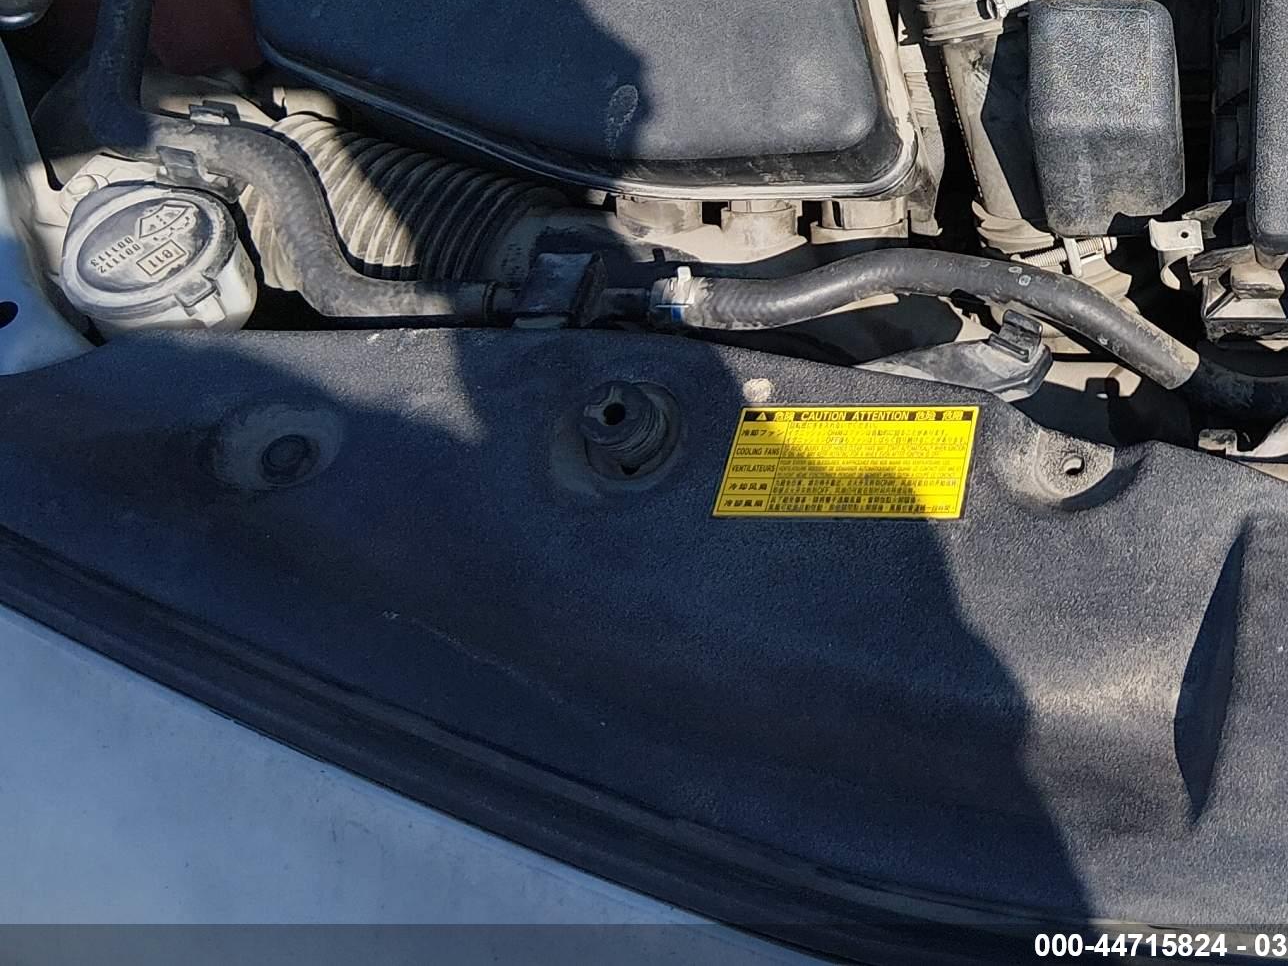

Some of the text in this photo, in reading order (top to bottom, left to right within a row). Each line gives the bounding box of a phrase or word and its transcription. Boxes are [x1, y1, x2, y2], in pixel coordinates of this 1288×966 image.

[800, 411, 847, 422] CAUTION
[852, 411, 910, 422] ATTENTION
[736, 447, 762, 455] COOLING
[764, 447, 780, 455] FANS
[731, 464, 776, 472] VENTILATEURS
